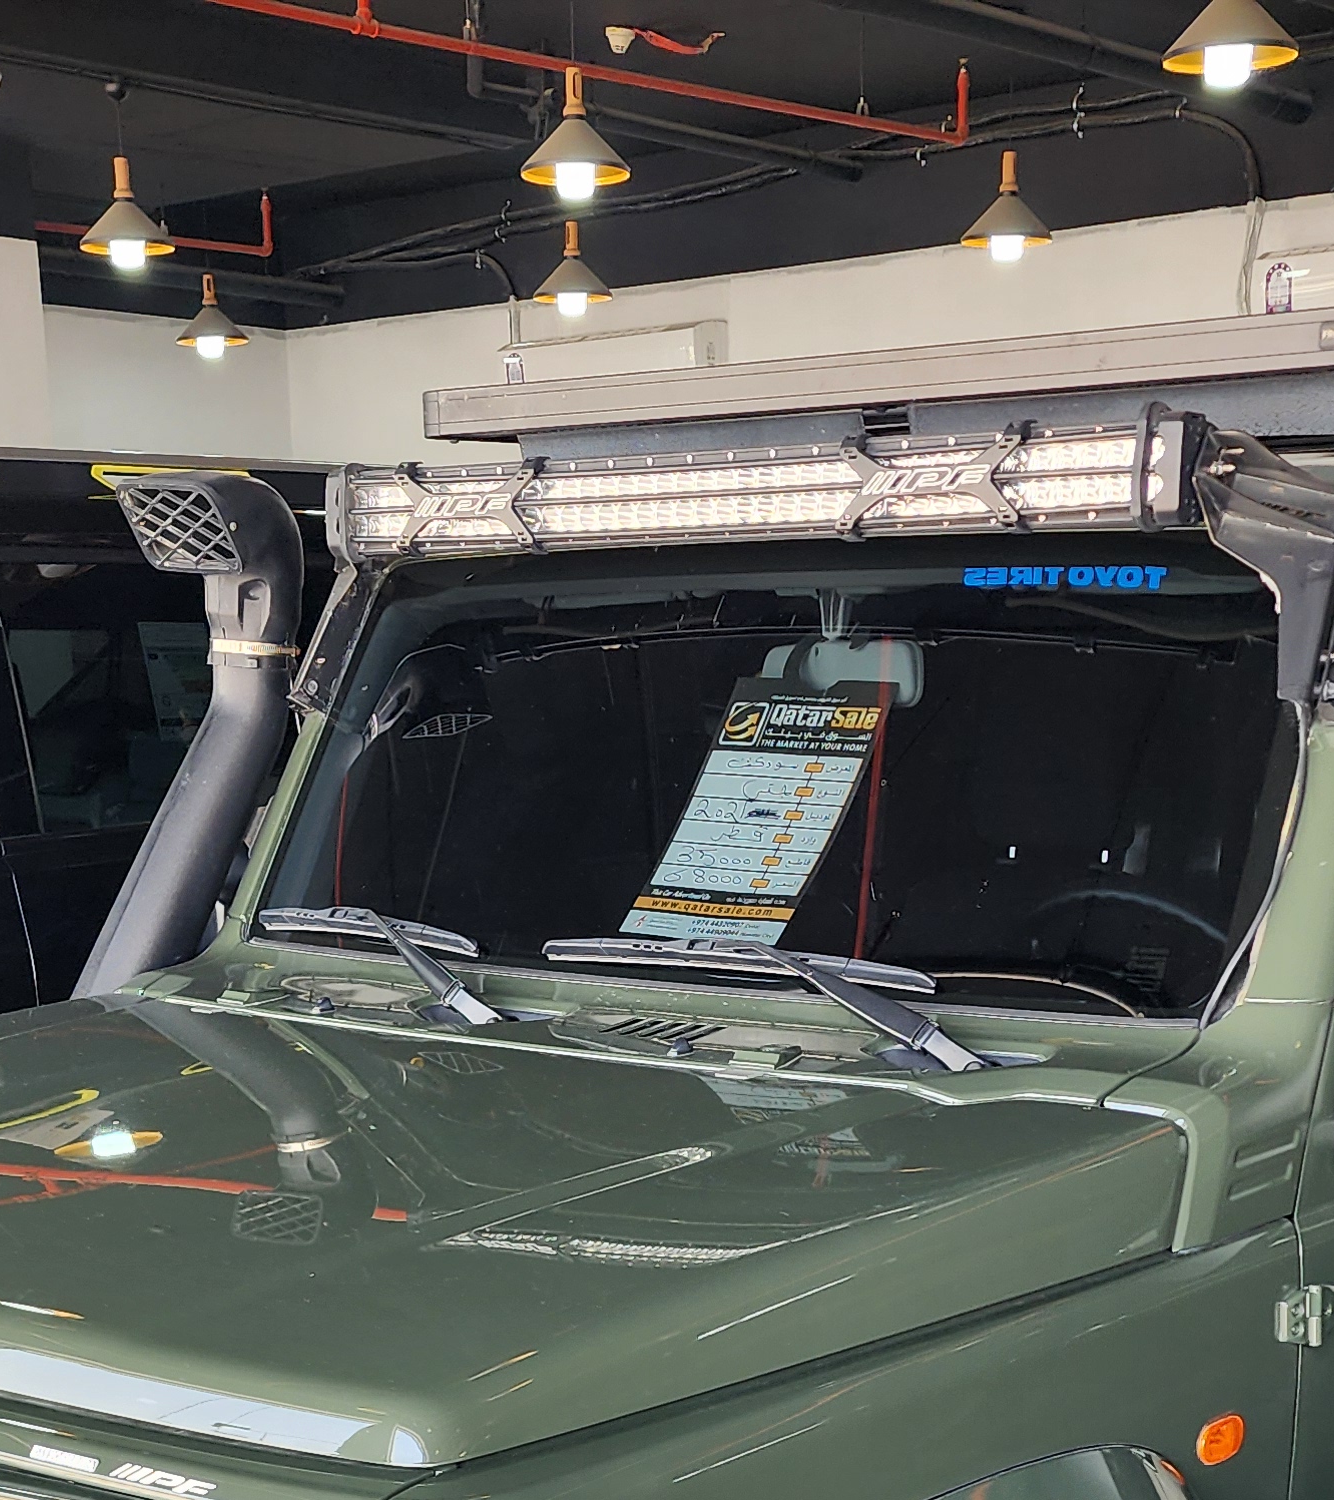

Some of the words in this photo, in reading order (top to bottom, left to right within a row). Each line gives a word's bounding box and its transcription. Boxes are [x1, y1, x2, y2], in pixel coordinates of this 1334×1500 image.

[770, 703, 882, 730] QatarSale
[761, 739, 775, 747] THE
[776, 740, 808, 750] MARKET
[809, 741, 819, 750] AT
[820, 742, 841, 751] YOUR
[843, 743, 868, 752] HOME
[650, 899, 773, 917] www.qatarsale.com
